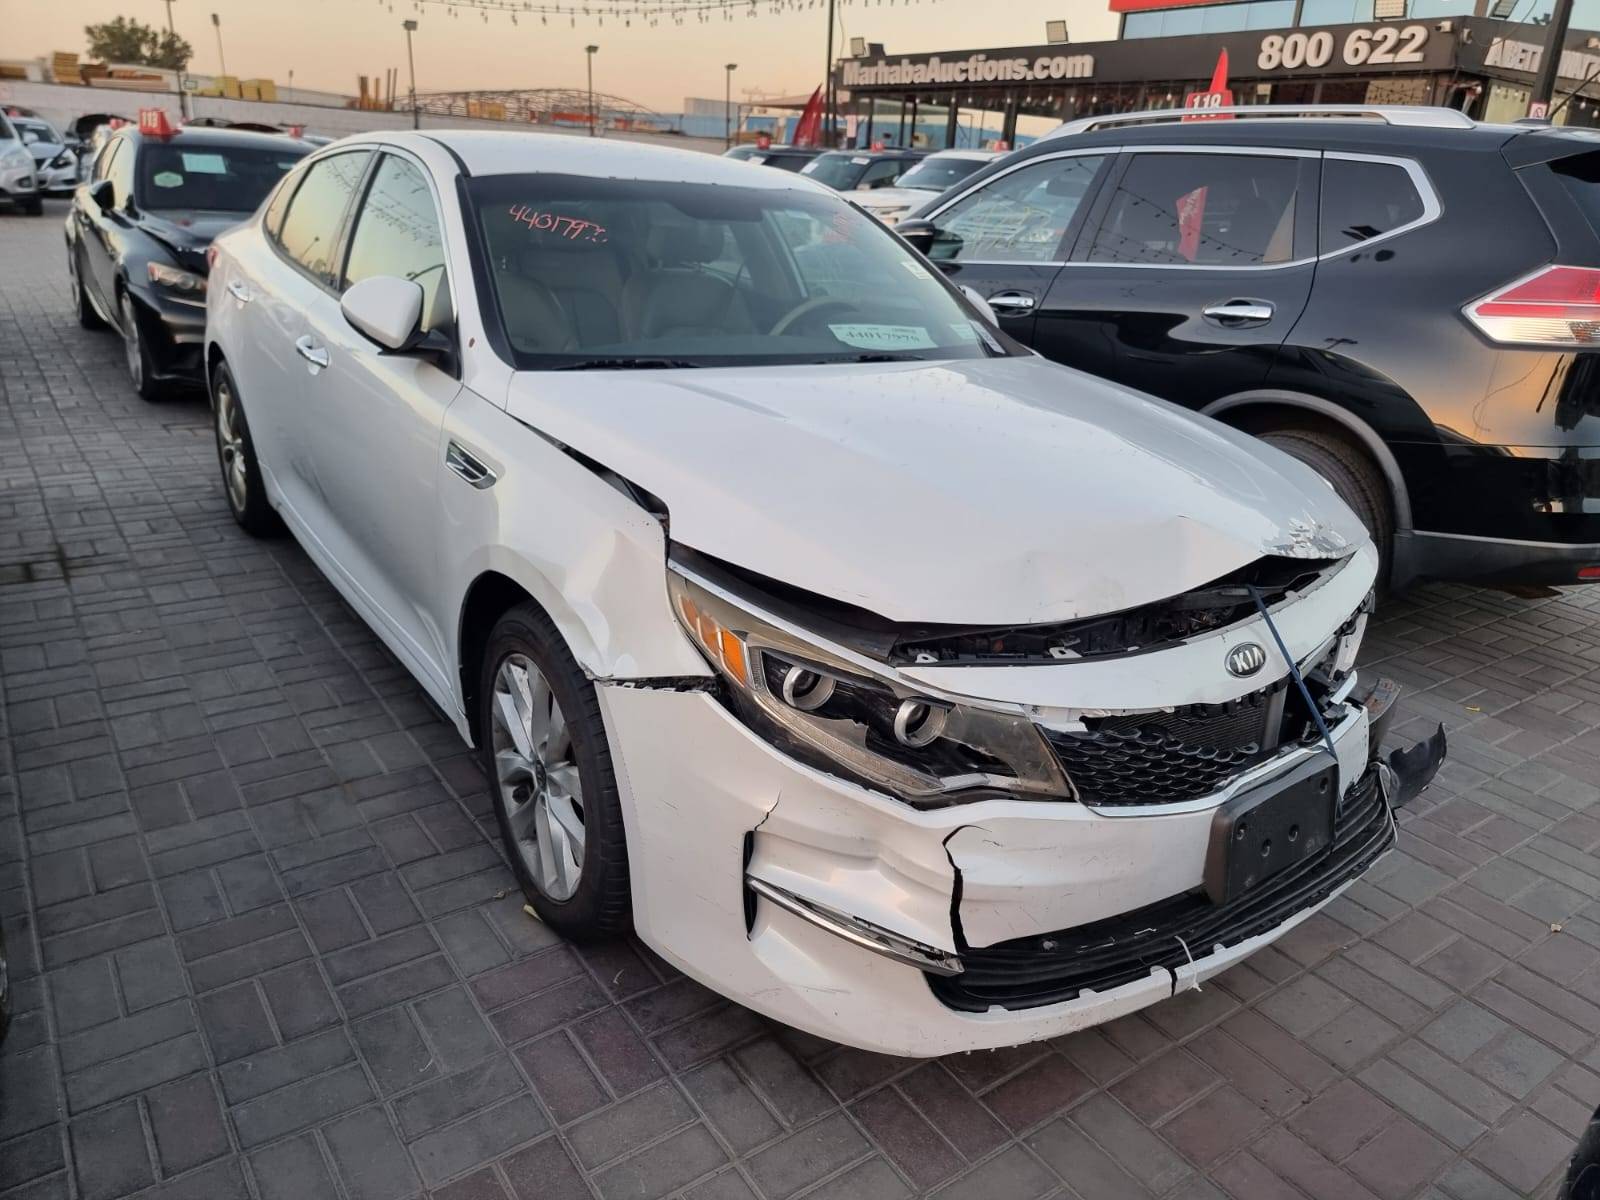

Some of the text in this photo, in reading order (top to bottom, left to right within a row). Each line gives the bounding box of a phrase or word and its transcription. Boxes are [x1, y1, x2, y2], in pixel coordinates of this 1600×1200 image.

[1257, 25, 1429, 70] 800 622
[843, 53, 1095, 86] MarhabaAuctions.com
[1232, 646, 1264, 673] KIA
